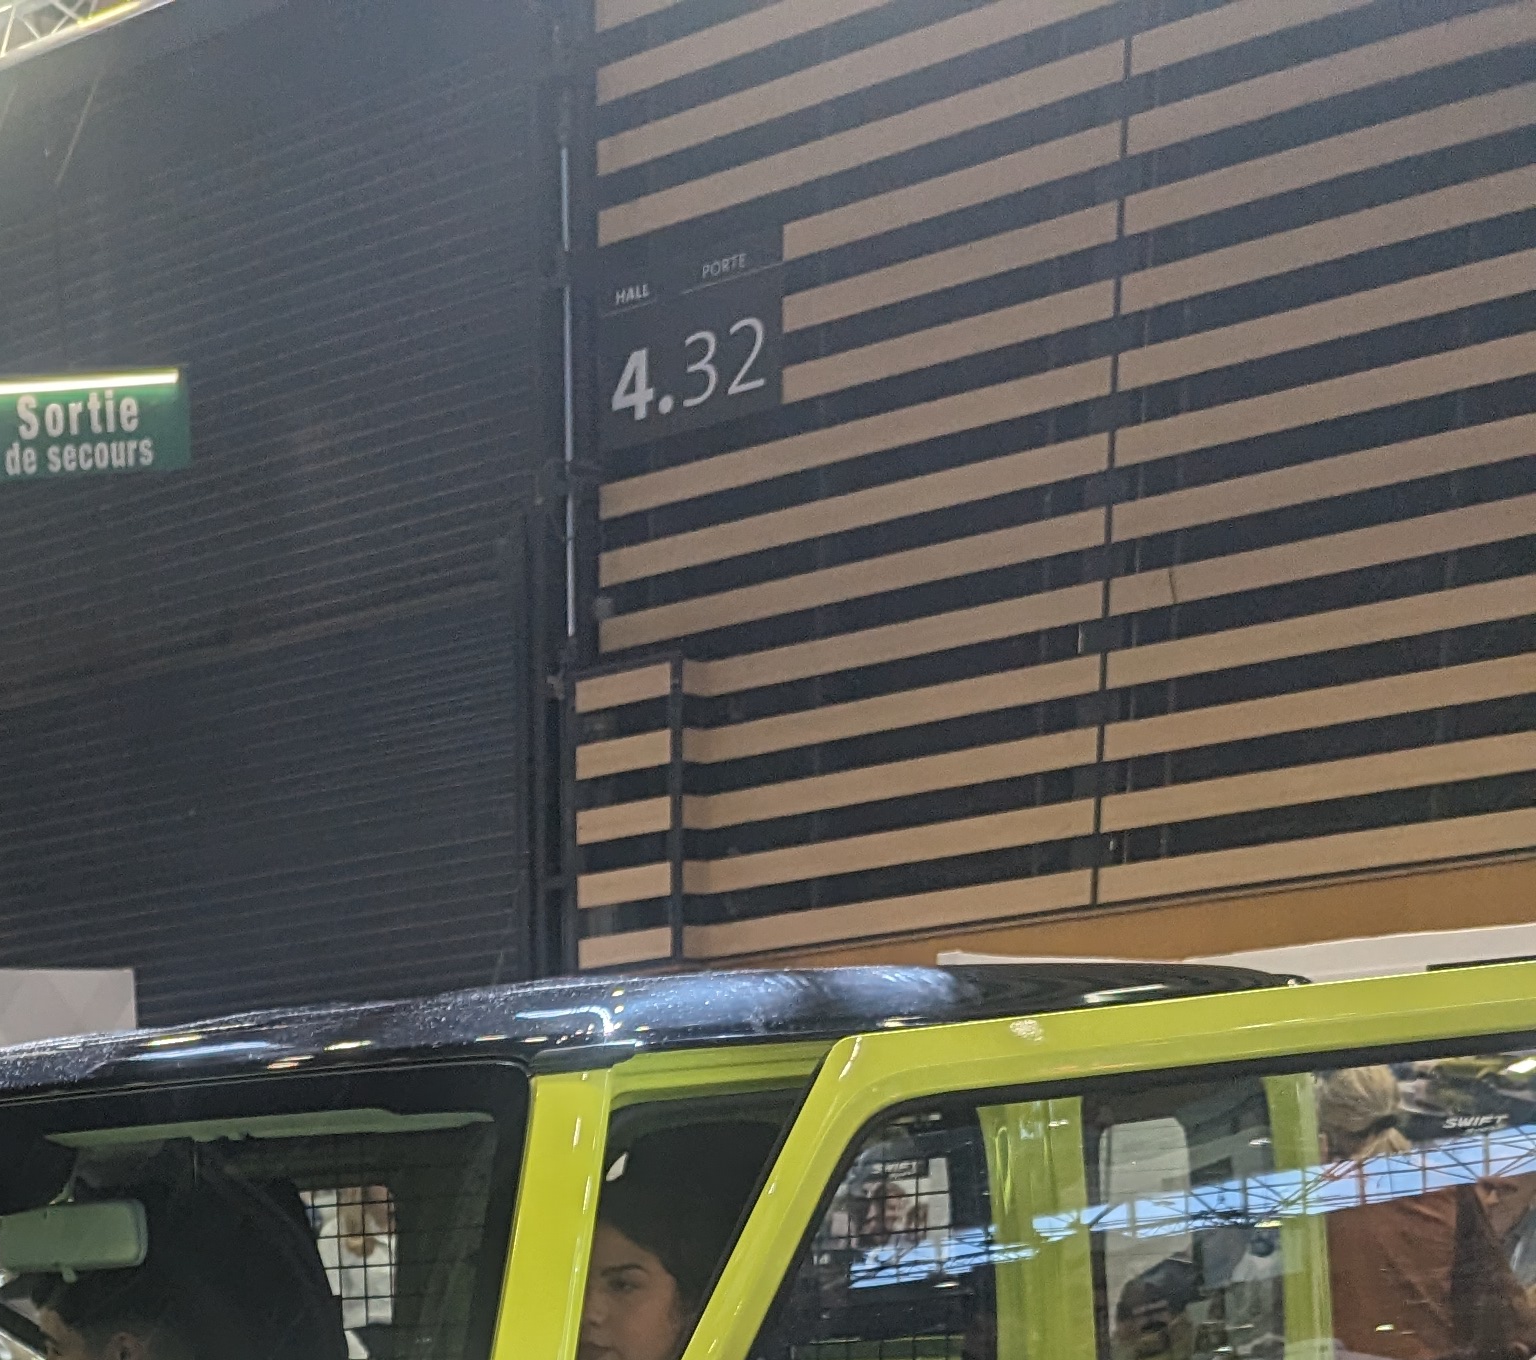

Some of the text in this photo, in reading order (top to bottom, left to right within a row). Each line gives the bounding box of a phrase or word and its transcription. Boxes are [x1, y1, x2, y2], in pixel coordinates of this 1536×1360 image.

[702, 253, 747, 278] PORTE
[611, 317, 766, 421] 4.32
[16, 389, 139, 440] Sortie
[5, 438, 154, 477] de secours
